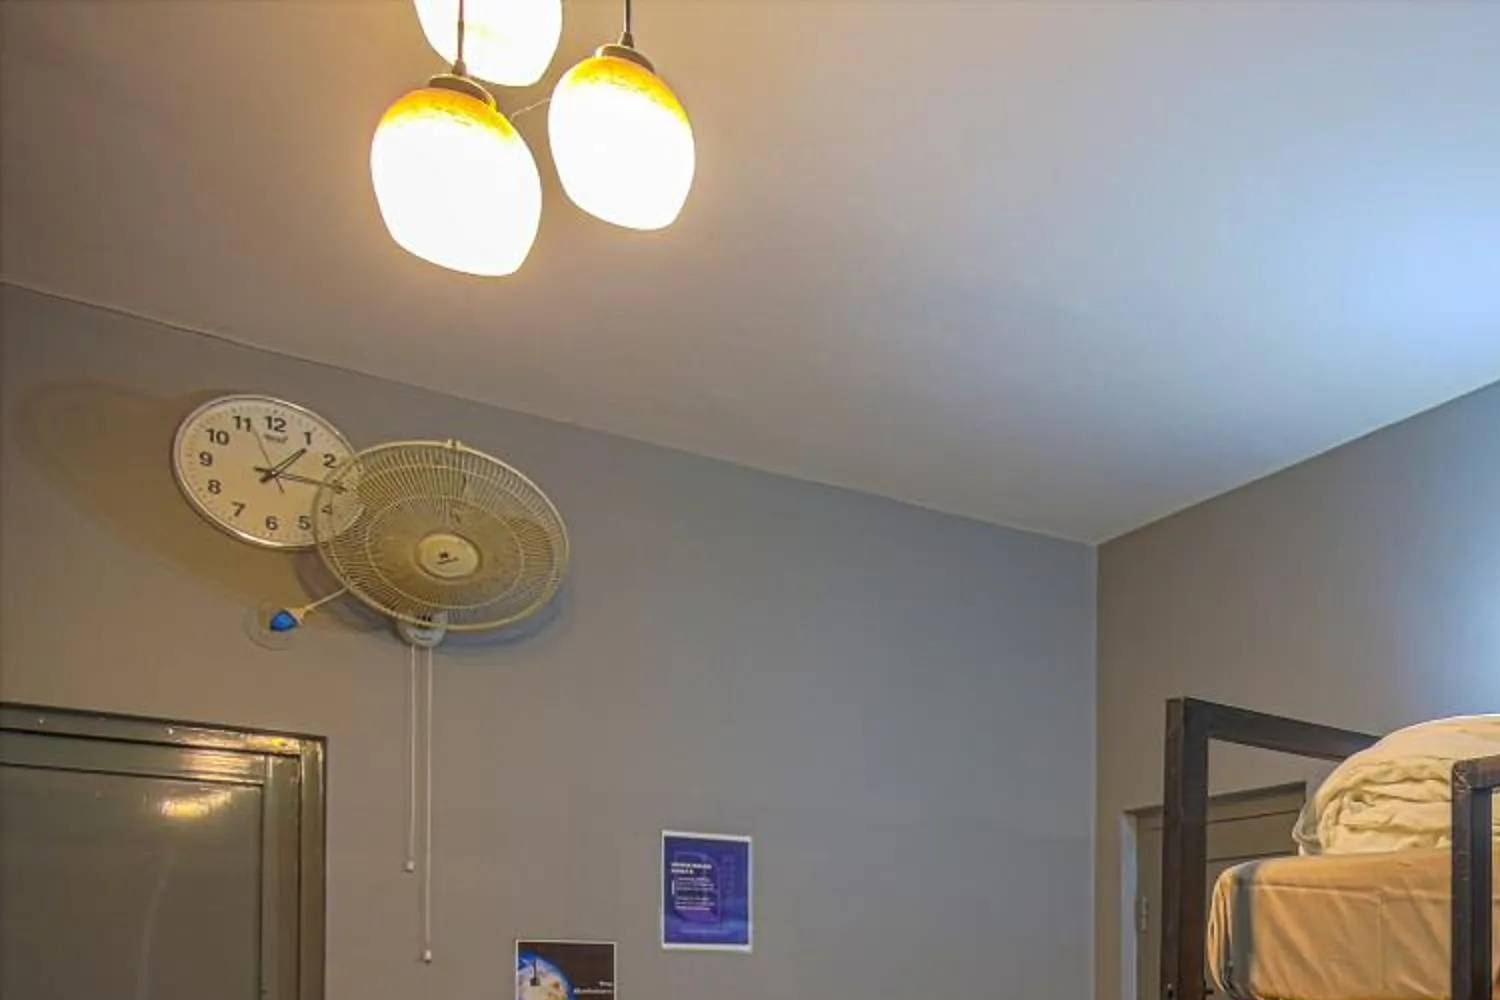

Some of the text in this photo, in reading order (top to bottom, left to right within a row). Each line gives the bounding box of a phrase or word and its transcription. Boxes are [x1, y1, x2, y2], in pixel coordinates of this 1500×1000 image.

[232, 415, 251, 432] 11
[264, 415, 287, 433] 12
[206, 428, 230, 446] 10
[304, 431, 312, 445] 1
[199, 451, 213, 467] 9
[322, 453, 337, 468] 2
[207, 479, 222, 495] 8
[231, 501, 246, 517] 7
[265, 515, 279, 531] 6
[298, 515, 312, 530] 5
